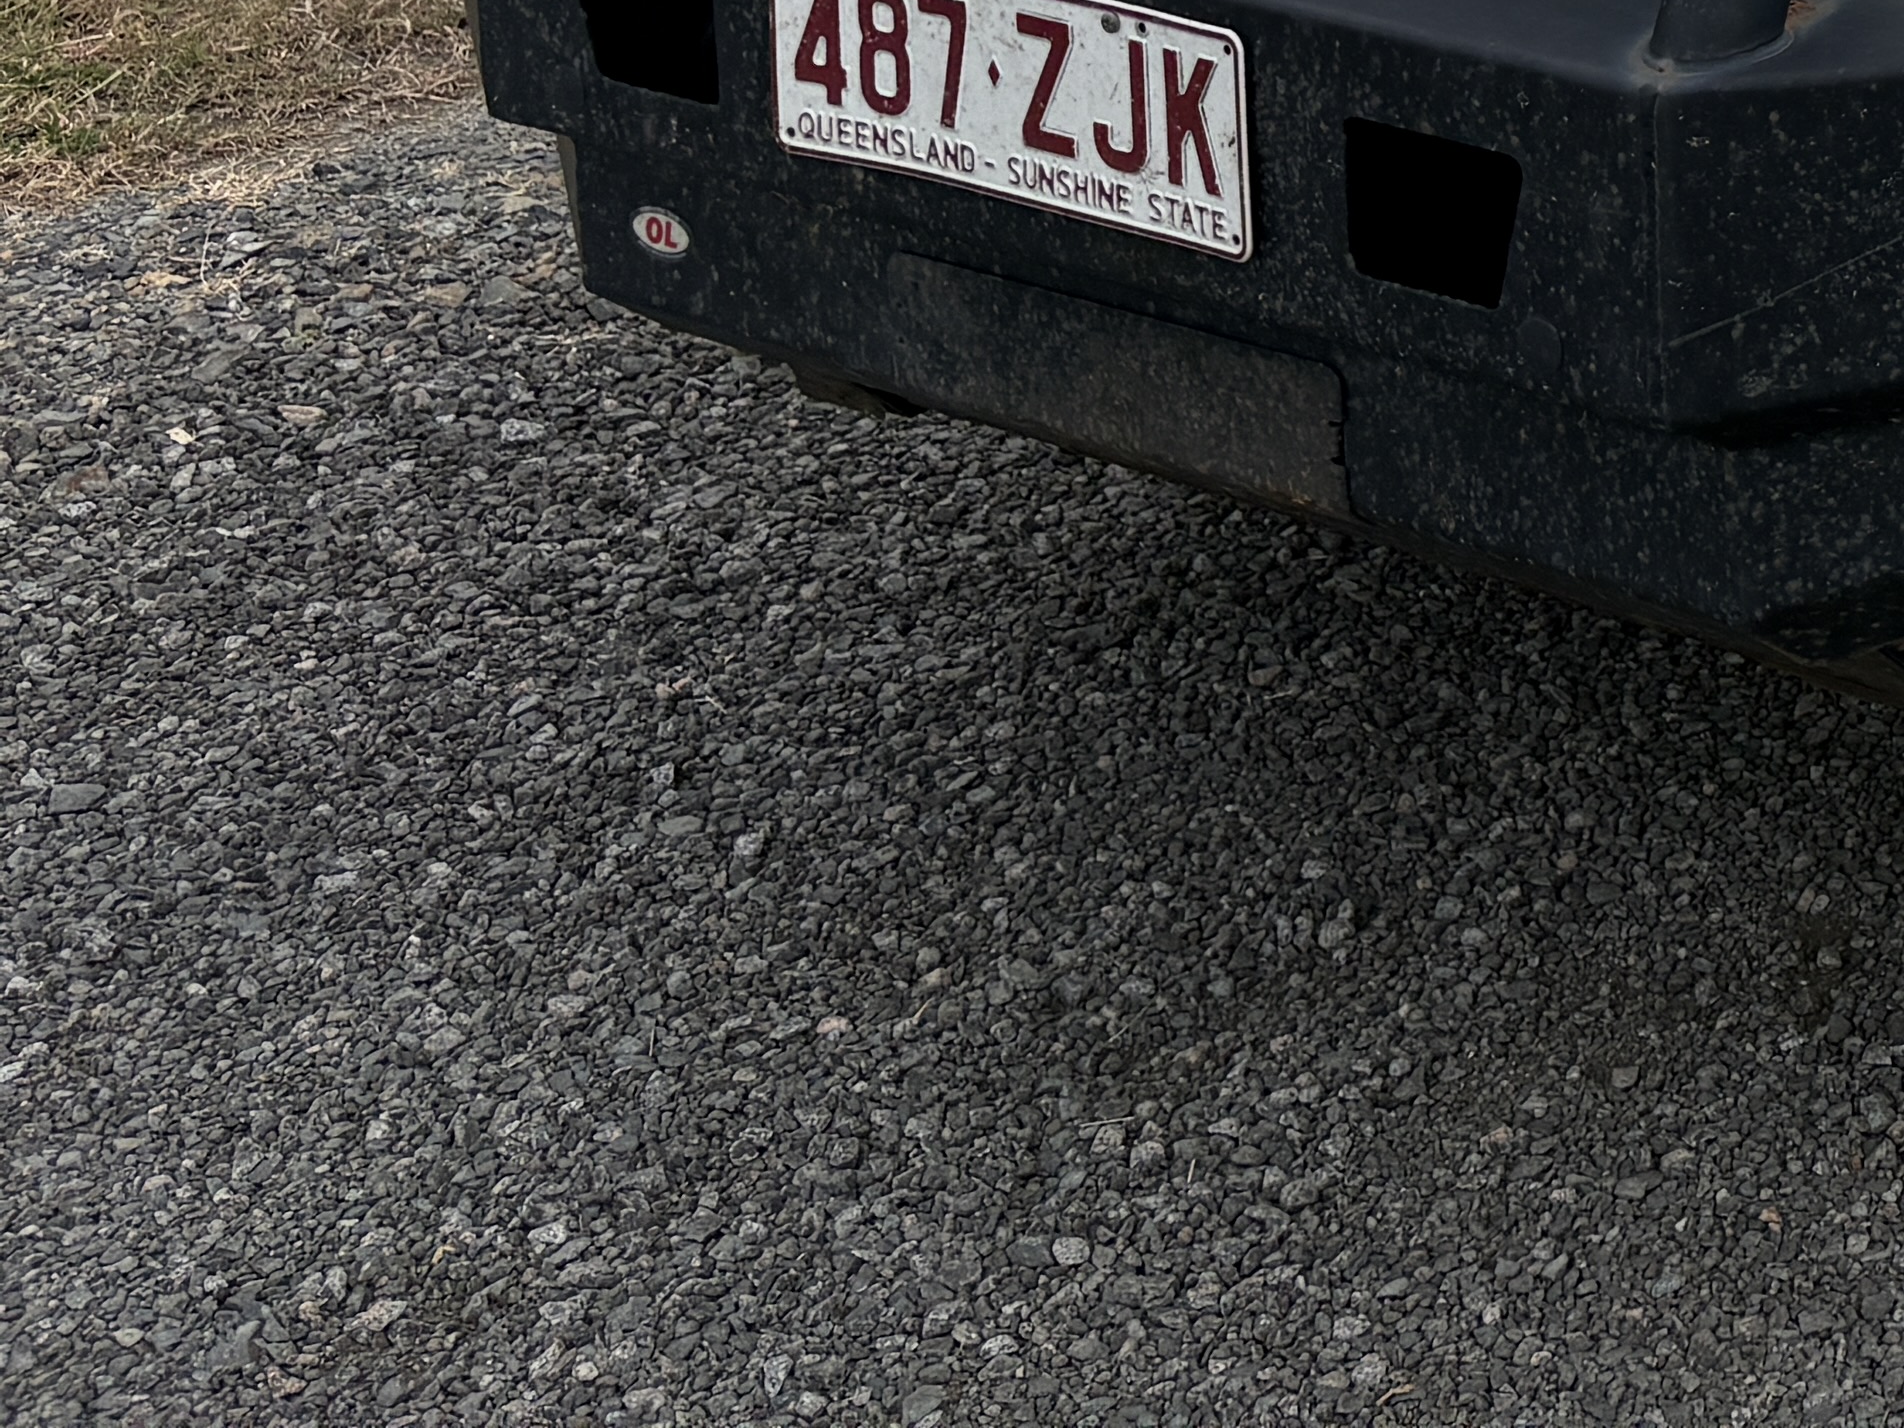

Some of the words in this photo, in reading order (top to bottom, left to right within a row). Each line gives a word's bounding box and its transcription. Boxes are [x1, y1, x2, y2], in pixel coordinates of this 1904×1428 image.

[1016, 11, 1223, 198] ZJK
[646, 216, 678, 249] OL
[799, 111, 975, 174] QUEENSLAND
[1008, 156, 1133, 214] SUNSHINE
[1148, 193, 1228, 241] STATE
